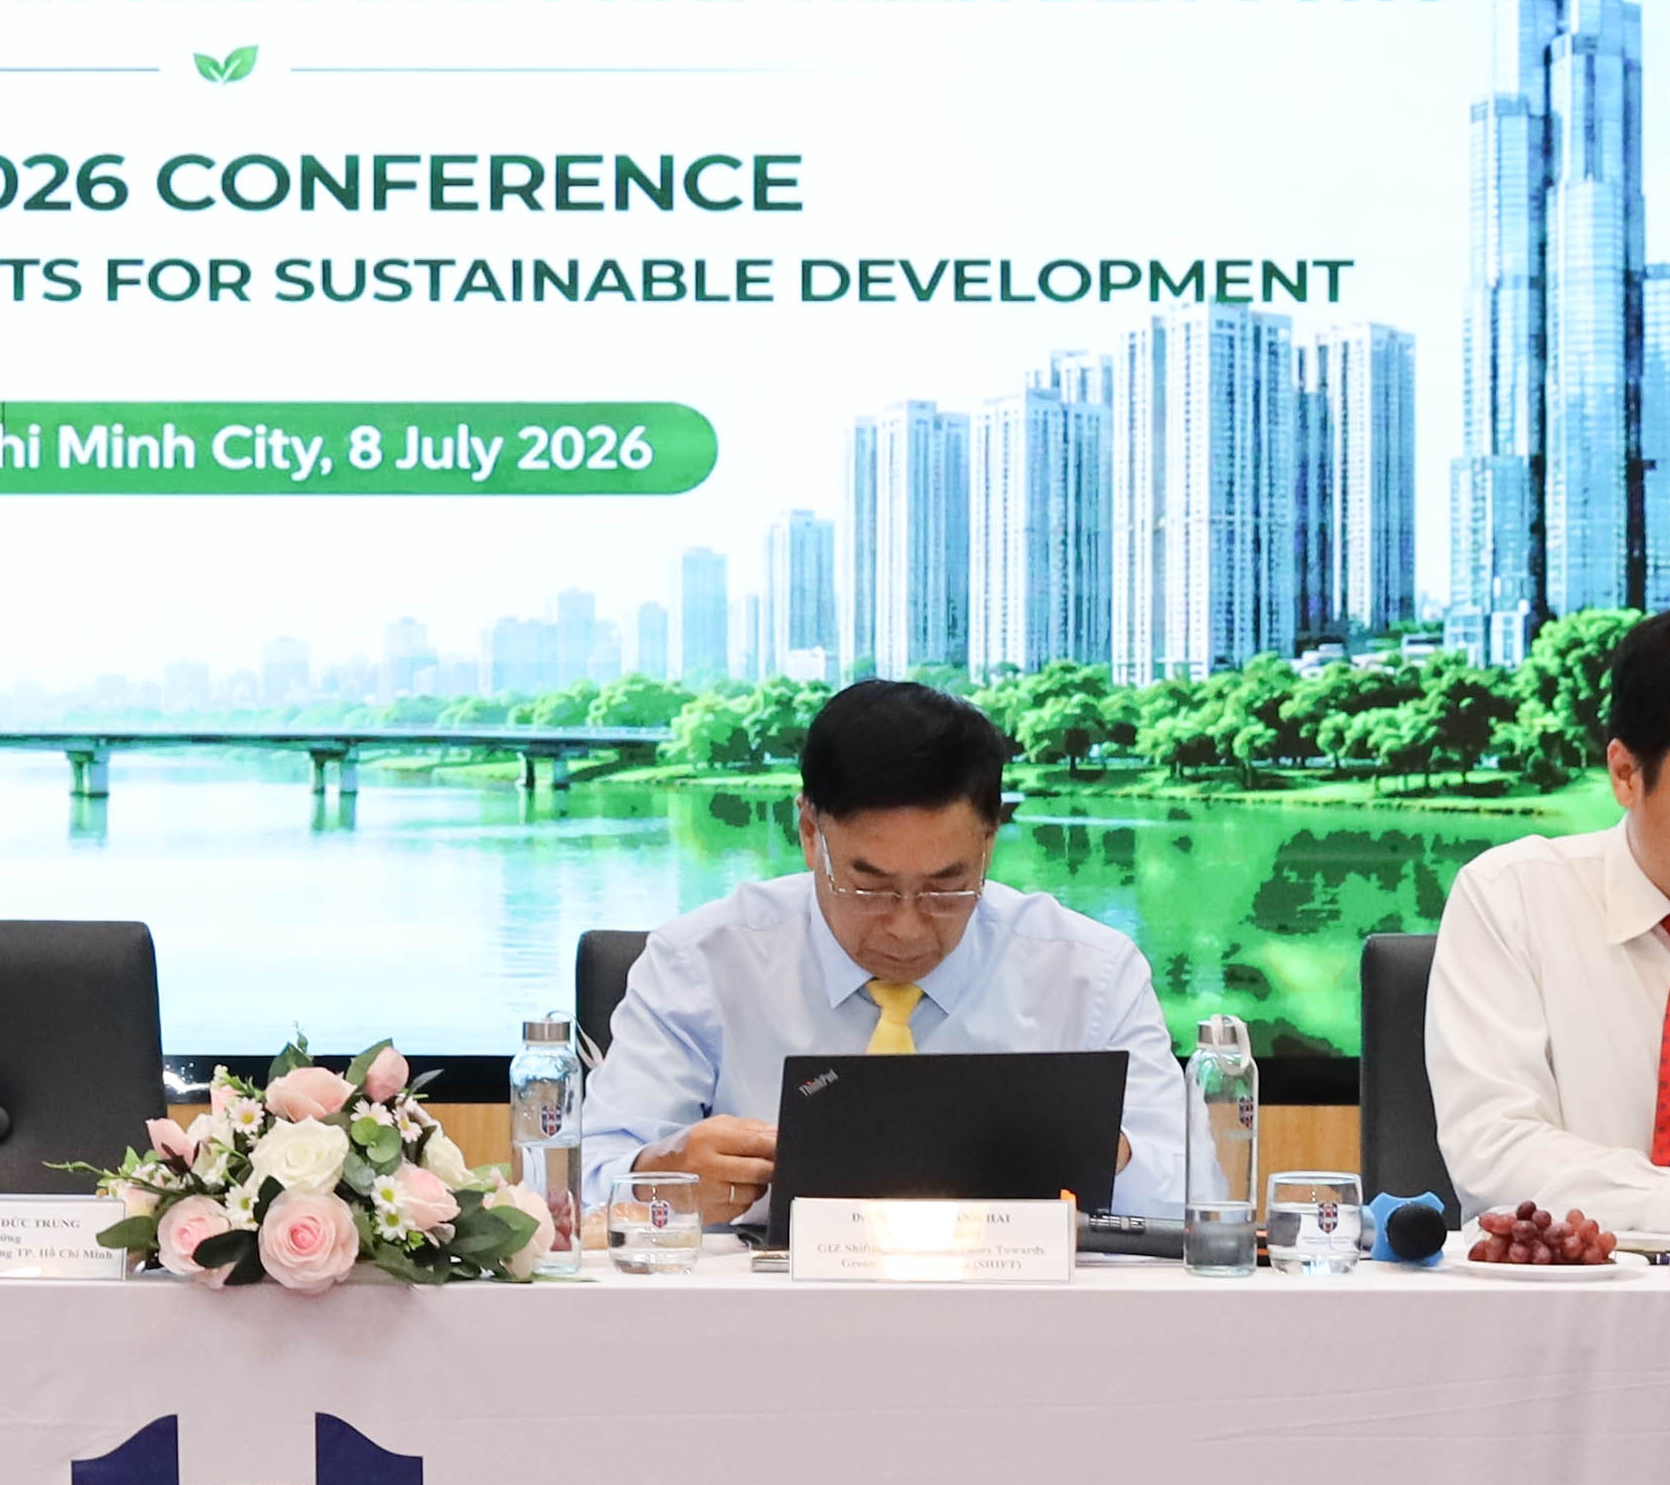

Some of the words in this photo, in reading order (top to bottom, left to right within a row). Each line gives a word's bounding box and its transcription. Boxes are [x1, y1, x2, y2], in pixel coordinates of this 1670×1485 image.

[156, 154, 803, 211] CONFERENCE
[107, 258, 251, 302] FOR
[275, 258, 774, 302] SUSTAINABLE
[801, 259, 1354, 303] DEVELOPMENT
[60, 424, 194, 468] Minh
[213, 424, 331, 480] City,
[350, 426, 381, 468] 8
[397, 425, 503, 480] July
[519, 426, 652, 469] 2026
[35, 1218, 80, 1229] TRUNG
